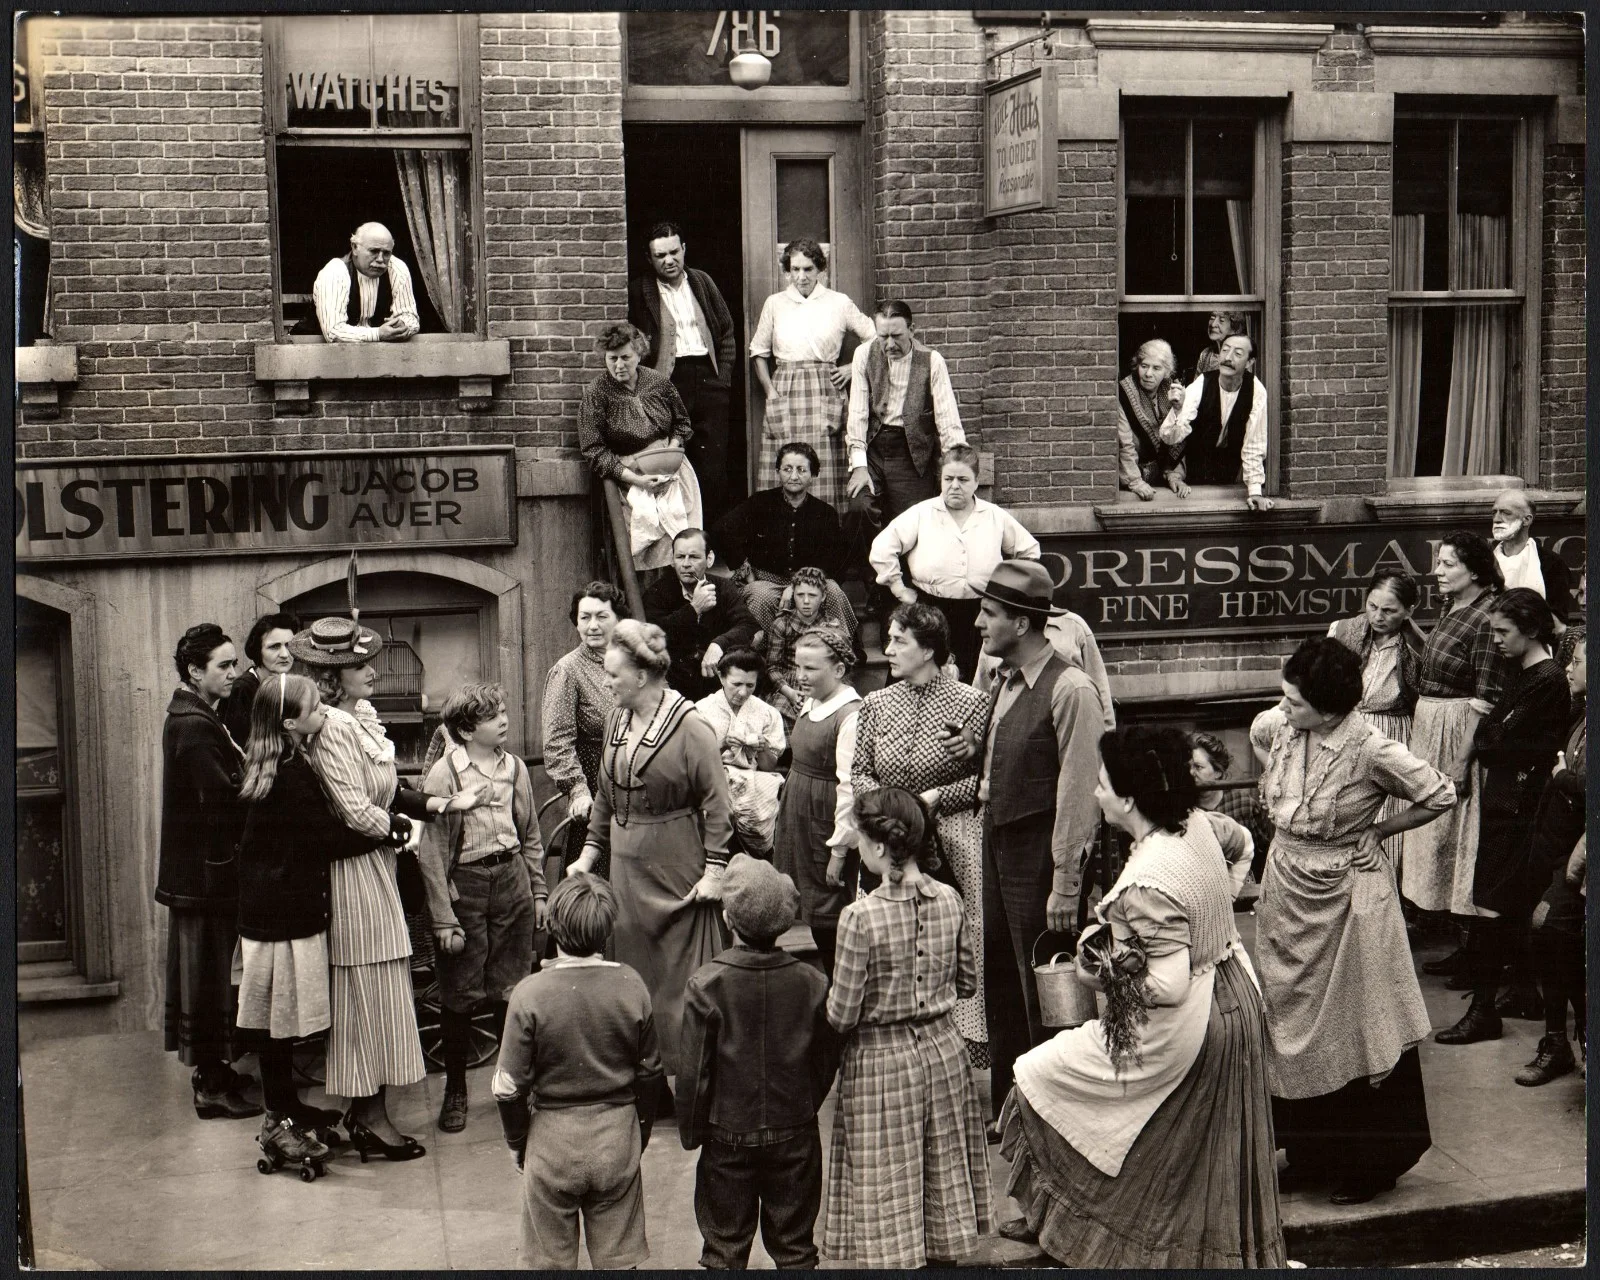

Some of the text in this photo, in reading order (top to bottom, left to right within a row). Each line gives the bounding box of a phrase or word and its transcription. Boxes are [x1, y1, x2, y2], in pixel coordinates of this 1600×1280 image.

[290, 72, 450, 112] WATCHES
[1009, 92, 1040, 138] Hats
[996, 140, 1037, 169] TO ORDER
[998, 168, 1035, 195] Reasonable
[339, 468, 479, 496] JACOB
[348, 500, 463, 529] AUER
[1098, 593, 1189, 623] FINE
